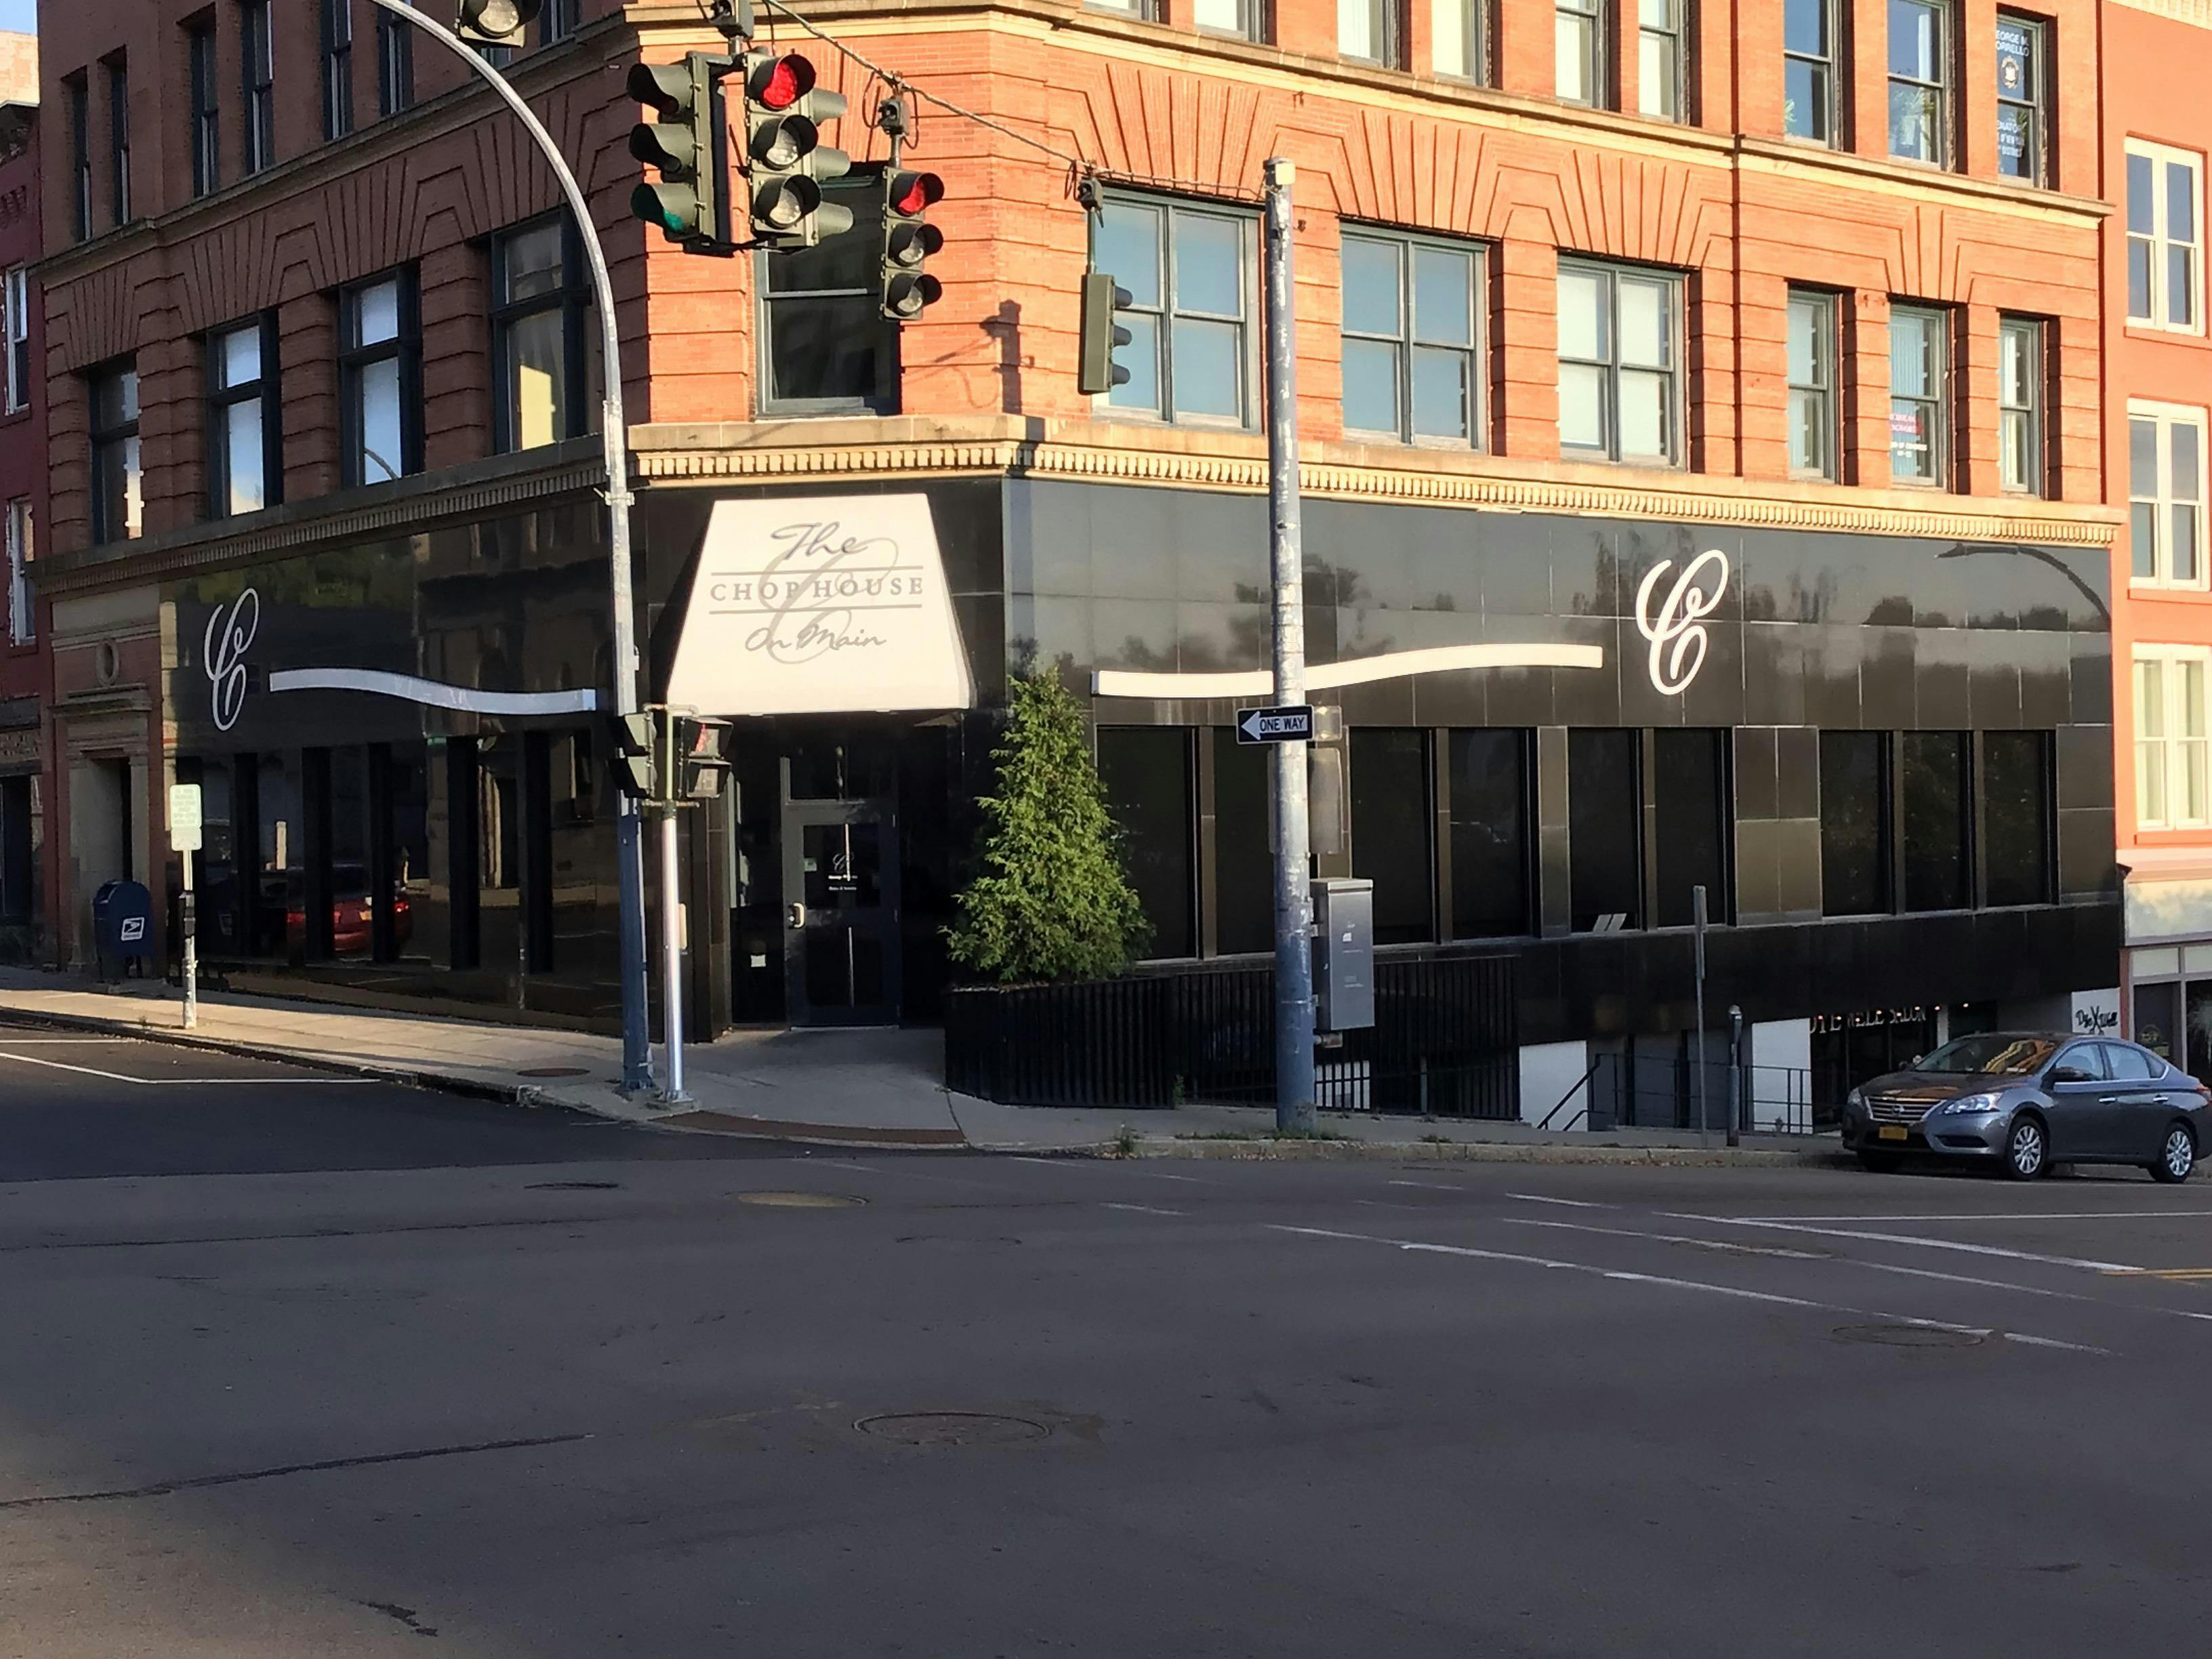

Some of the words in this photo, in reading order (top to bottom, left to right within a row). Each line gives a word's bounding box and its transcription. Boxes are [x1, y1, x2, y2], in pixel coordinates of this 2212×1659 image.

[1995, 30, 2020, 45] EORGE
[1995, 41, 2030, 57] ORRELLO
[770, 521, 868, 560] The
[710, 579, 800, 602] CHOP
[813, 577, 924, 598] HOUSE
[745, 627, 792, 652] On
[796, 623, 886, 651] Main
[1260, 718, 1280, 732] ONE
[1283, 716, 1305, 730] WAY
